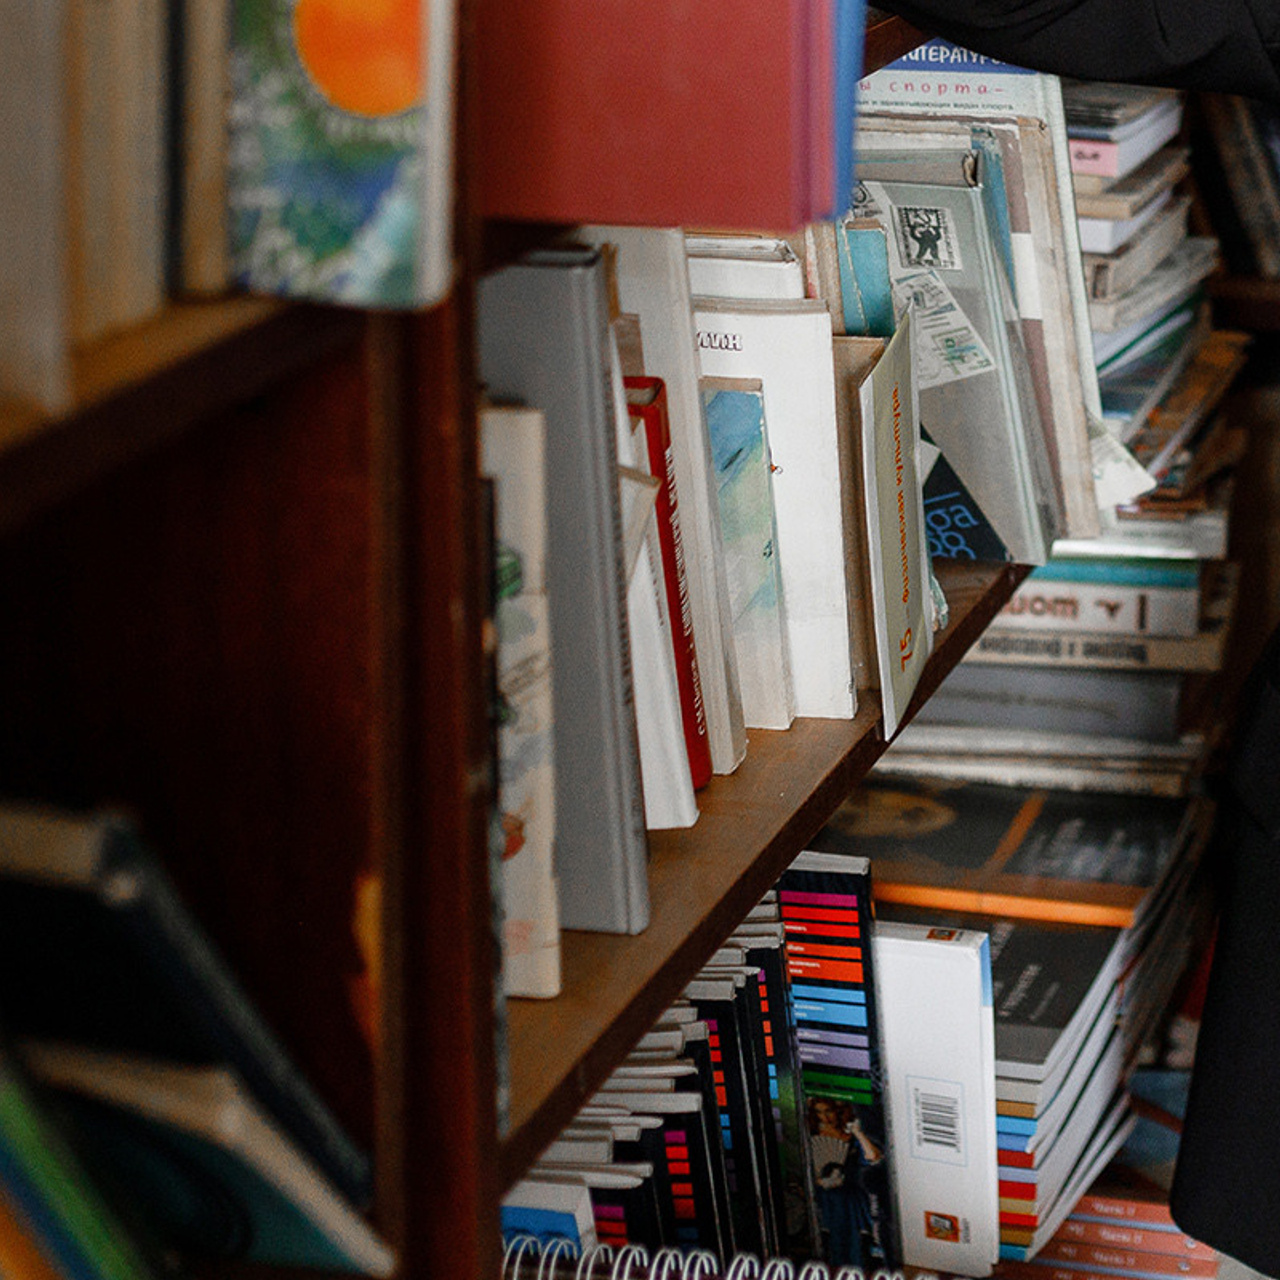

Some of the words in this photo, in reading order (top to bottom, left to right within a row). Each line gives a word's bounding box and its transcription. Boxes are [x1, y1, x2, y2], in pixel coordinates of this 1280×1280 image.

[902, 45, 1006, 66] ИТЕРАТУР
[889, 81, 988, 96] спорта
[900, 627, 913, 672] 75
